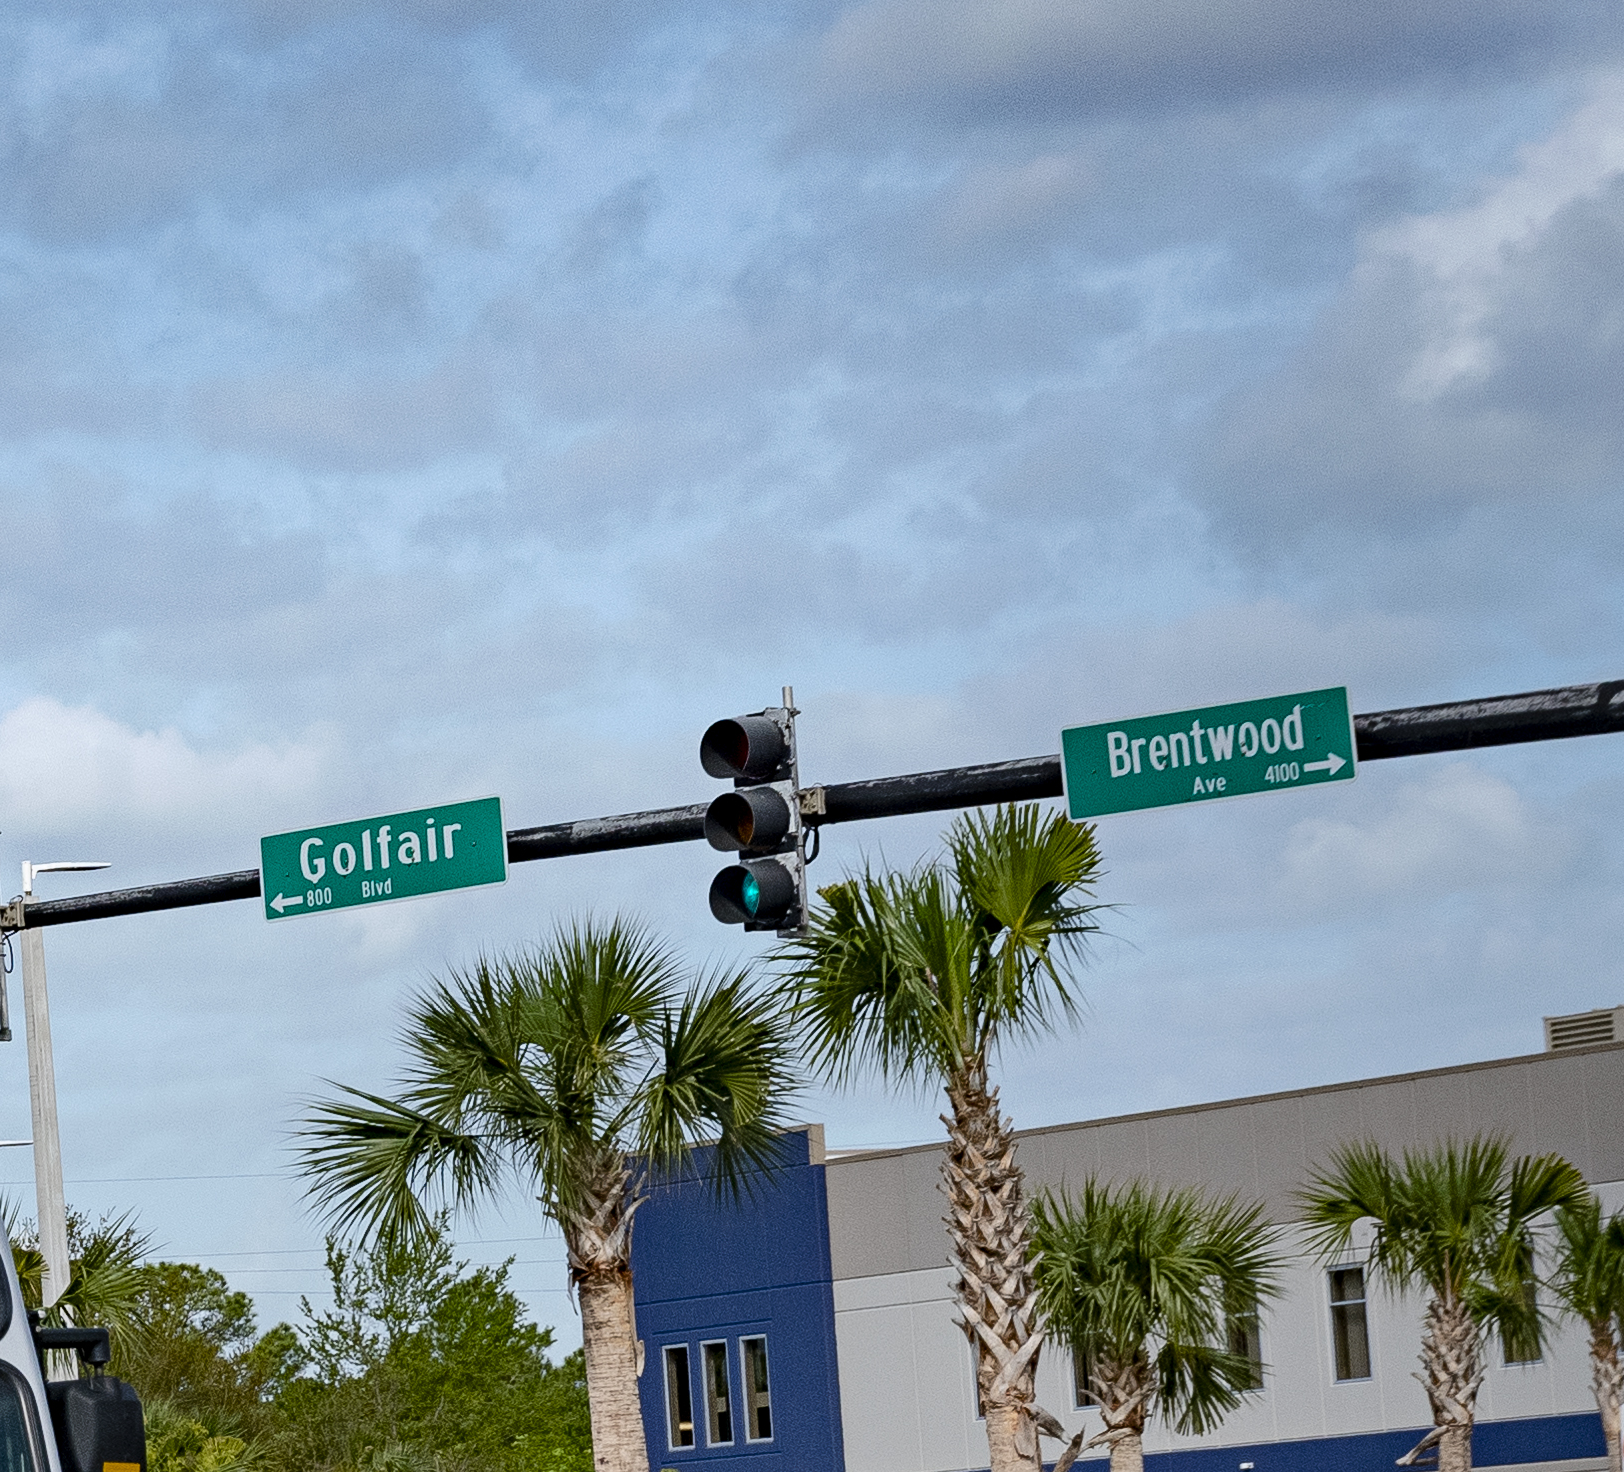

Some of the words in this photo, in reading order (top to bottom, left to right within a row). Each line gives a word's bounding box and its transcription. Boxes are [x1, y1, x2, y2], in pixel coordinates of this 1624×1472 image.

[1107, 704, 1304, 778] Brentwood
[1192, 776, 1227, 795] Ave
[1264, 762, 1299, 783] 4100
[300, 818, 462, 883] Golfair
[307, 887, 332, 907] 800
[362, 878, 393, 898] Blvd
